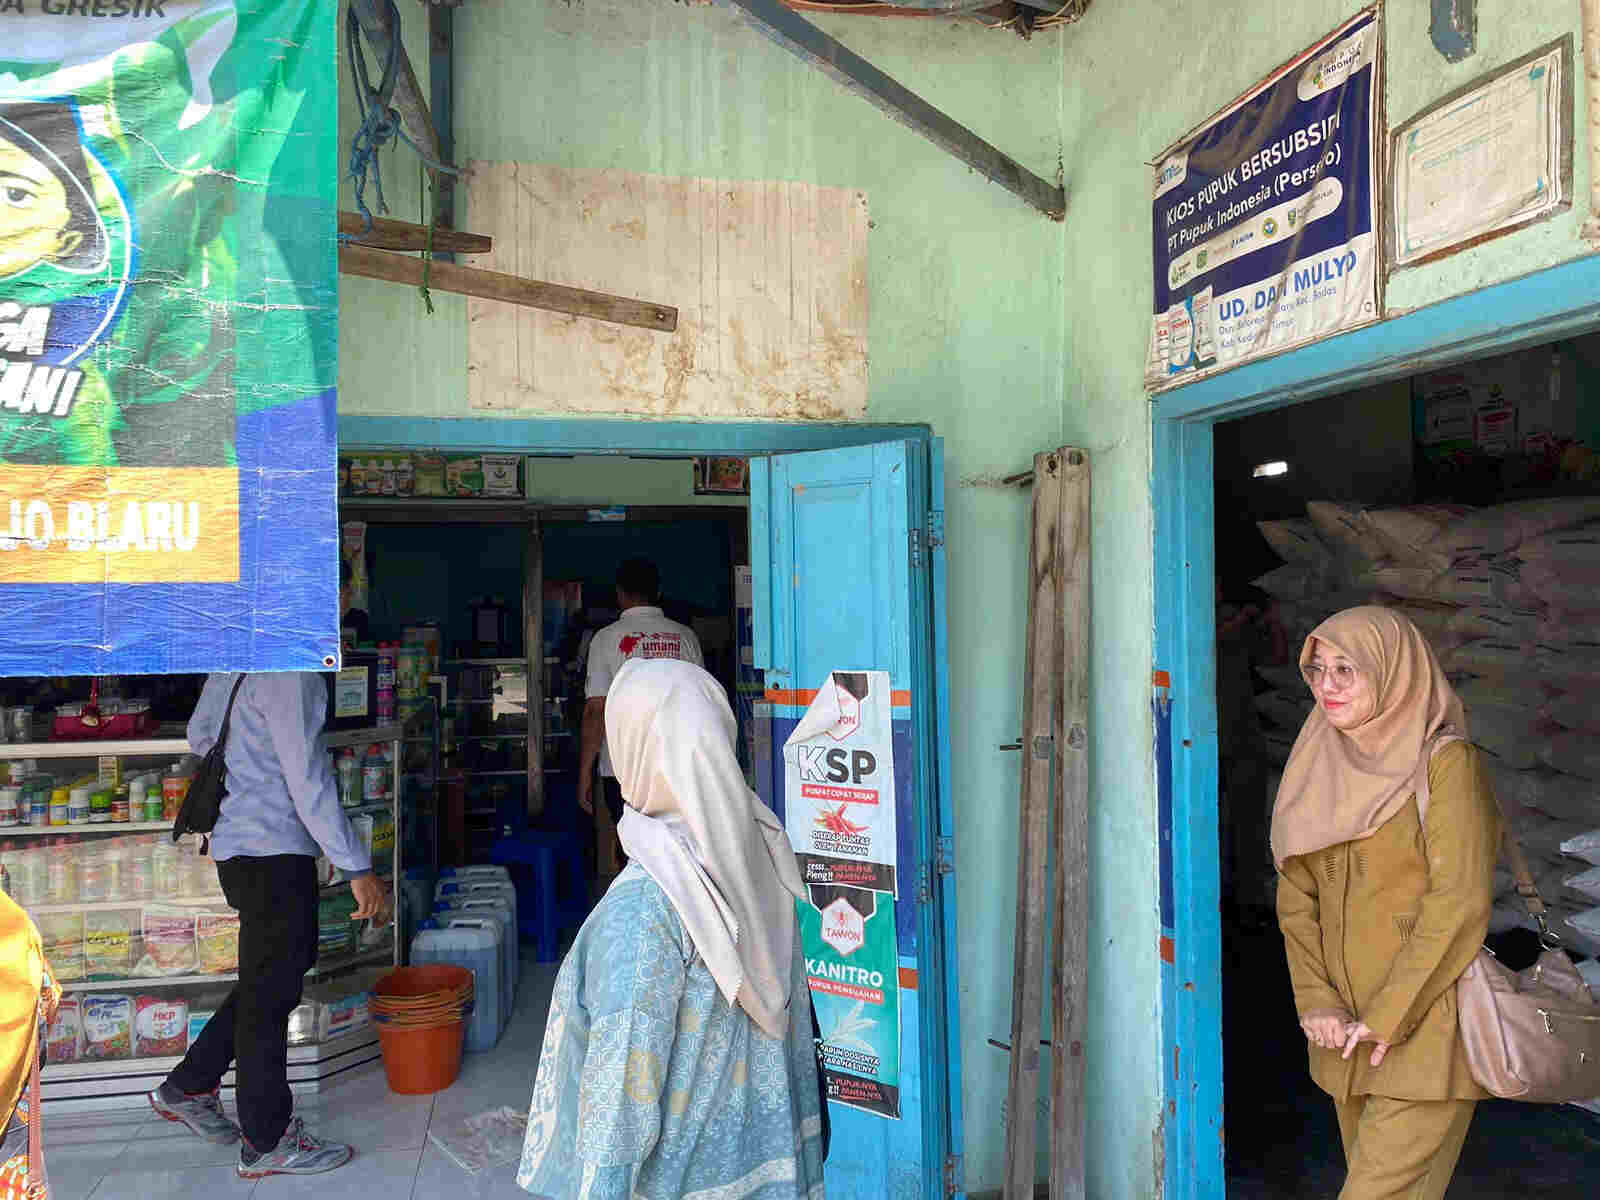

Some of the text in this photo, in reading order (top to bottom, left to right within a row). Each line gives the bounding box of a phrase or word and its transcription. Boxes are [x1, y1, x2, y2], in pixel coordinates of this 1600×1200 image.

[41, 0, 166, 18] GRESIK
[1167, 196, 1194, 227] KIOS
[1198, 168, 1238, 211] PUPUK
[1167, 233, 1178, 257] PT
[1180, 216, 1213, 246] Pupuk
[1217, 184, 1270, 227] Indonesia
[1274, 142, 1341, 197] (Perso)
[1219, 298, 1248, 321] UD.
[0, 358, 83, 416] ANI
[67, 499, 200, 551] BLARU
[798, 744, 877, 784] KSP
[805, 958, 883, 987] KANITRO
